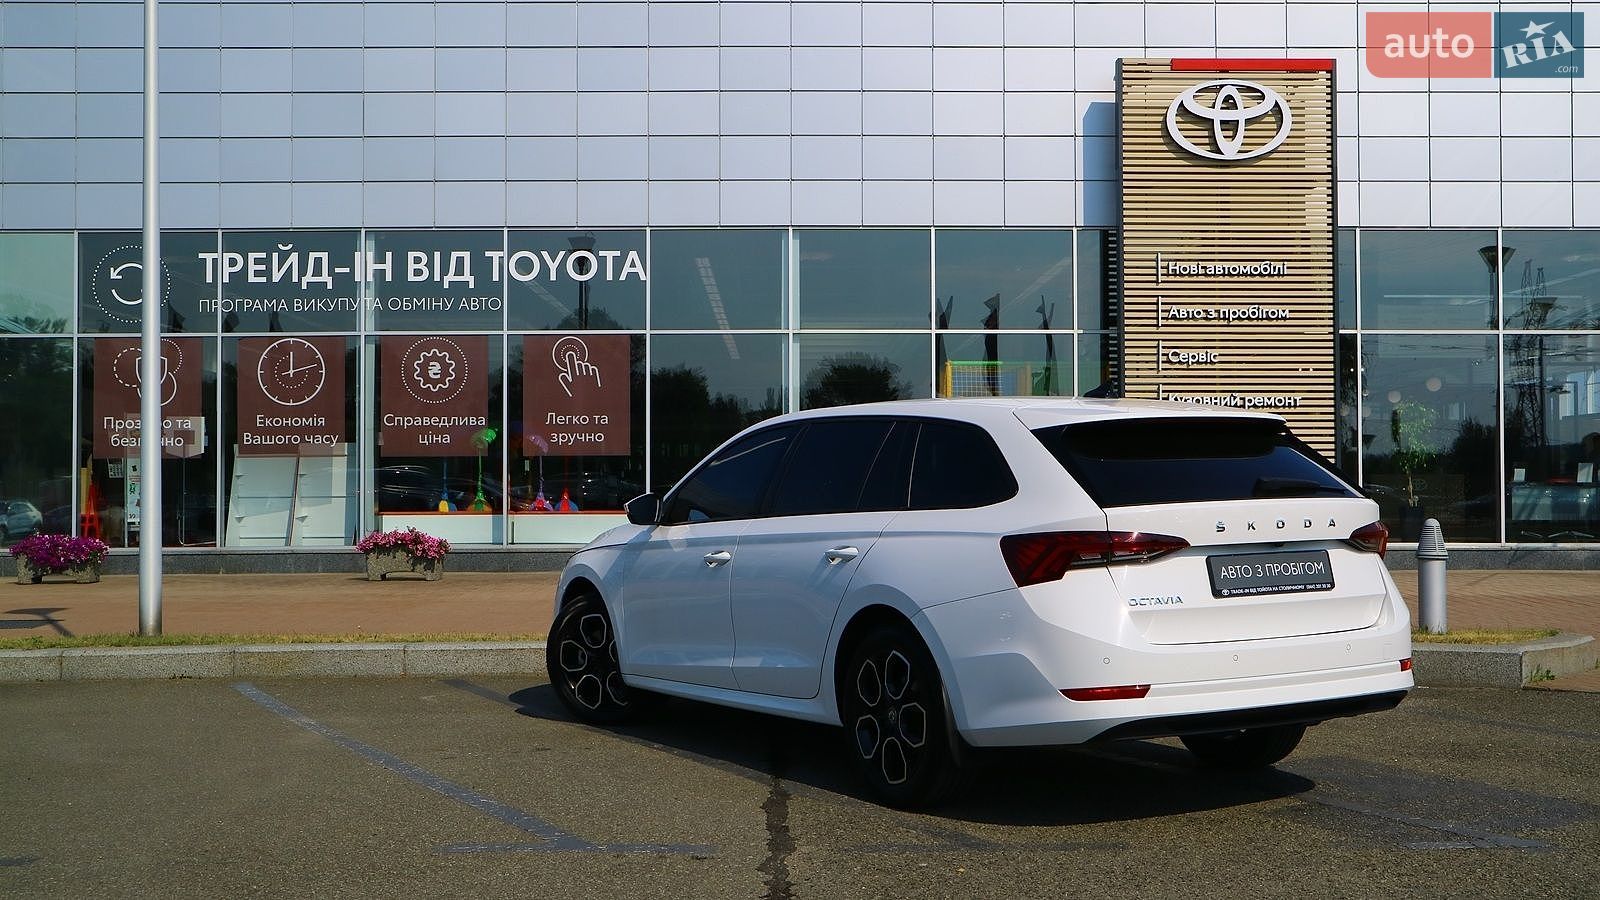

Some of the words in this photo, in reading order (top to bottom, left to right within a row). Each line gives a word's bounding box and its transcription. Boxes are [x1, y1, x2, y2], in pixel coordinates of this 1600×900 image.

[198, 243, 393, 290] ТРЕЙД-ІН
[407, 251, 475, 289] ВІД
[485, 250, 647, 282] TOYOTA
[1168, 261, 1201, 275] Нові
[1206, 260, 1288, 275] автомобілі
[199, 298, 289, 313] ПРОГРАМА
[293, 297, 361, 312] ВИКУПУ
[363, 297, 383, 311] ТА
[387, 296, 454, 311] ОБМІНУ
[458, 297, 502, 311] АВТО
[1168, 305, 1204, 319] Авто
[1207, 309, 1215, 319] з
[1219, 304, 1290, 322] пробігом
[1168, 348, 1219, 365] Сервіс
[1245, 396, 1302, 409] ремонт
[103, 416, 172, 433] Прозо
[176, 418, 192, 430] та
[256, 414, 326, 427] Економія
[383, 413, 486, 427] Справедлива
[545, 412, 589, 425] Легко
[593, 415, 609, 425] та
[110, 433, 184, 447] безно
[243, 433, 301, 445] Вашого
[304, 436, 339, 448] часу
[418, 431, 451, 444] ціна
[550, 433, 605, 444] зручно
[1215, 518, 1337, 533] ŠKODA
[1220, 564, 1253, 579] АВТО
[1265, 561, 1326, 577] ПРОБІГОМ
[1127, 594, 1184, 607] OCTAVIA
